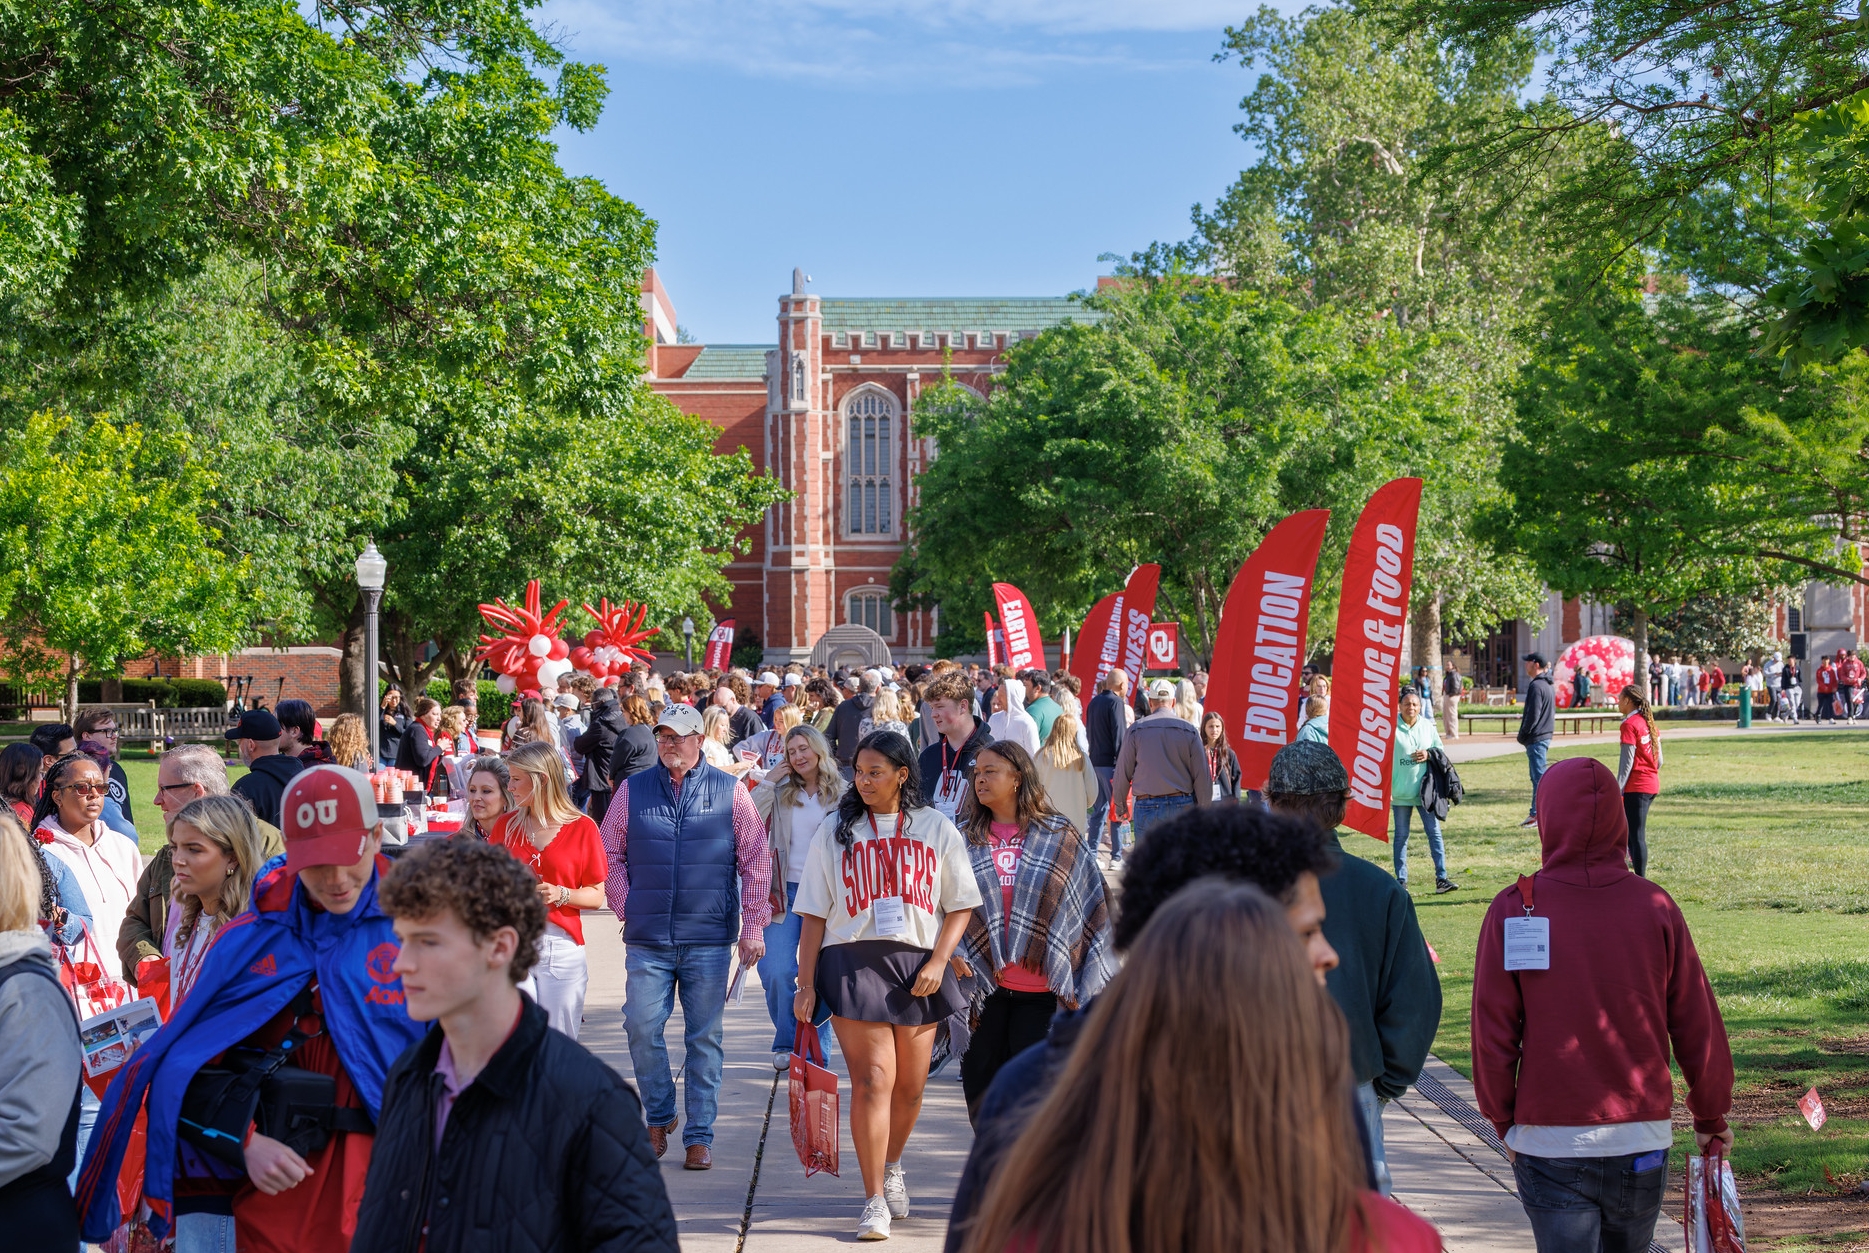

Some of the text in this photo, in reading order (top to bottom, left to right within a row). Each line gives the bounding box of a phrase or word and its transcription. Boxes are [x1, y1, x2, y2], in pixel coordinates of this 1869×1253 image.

[1002, 599, 1030, 653] EARTH
[712, 641, 723, 668] ENGIN
[1012, 651, 1033, 668] &
[1243, 570, 1306, 745] EDUCATION
[1350, 523, 1404, 811] HOUSING & FOOD
[662, 704, 689, 715] DALLAS
[296, 799, 338, 829] OU
[841, 837, 937, 918] SOONERS
